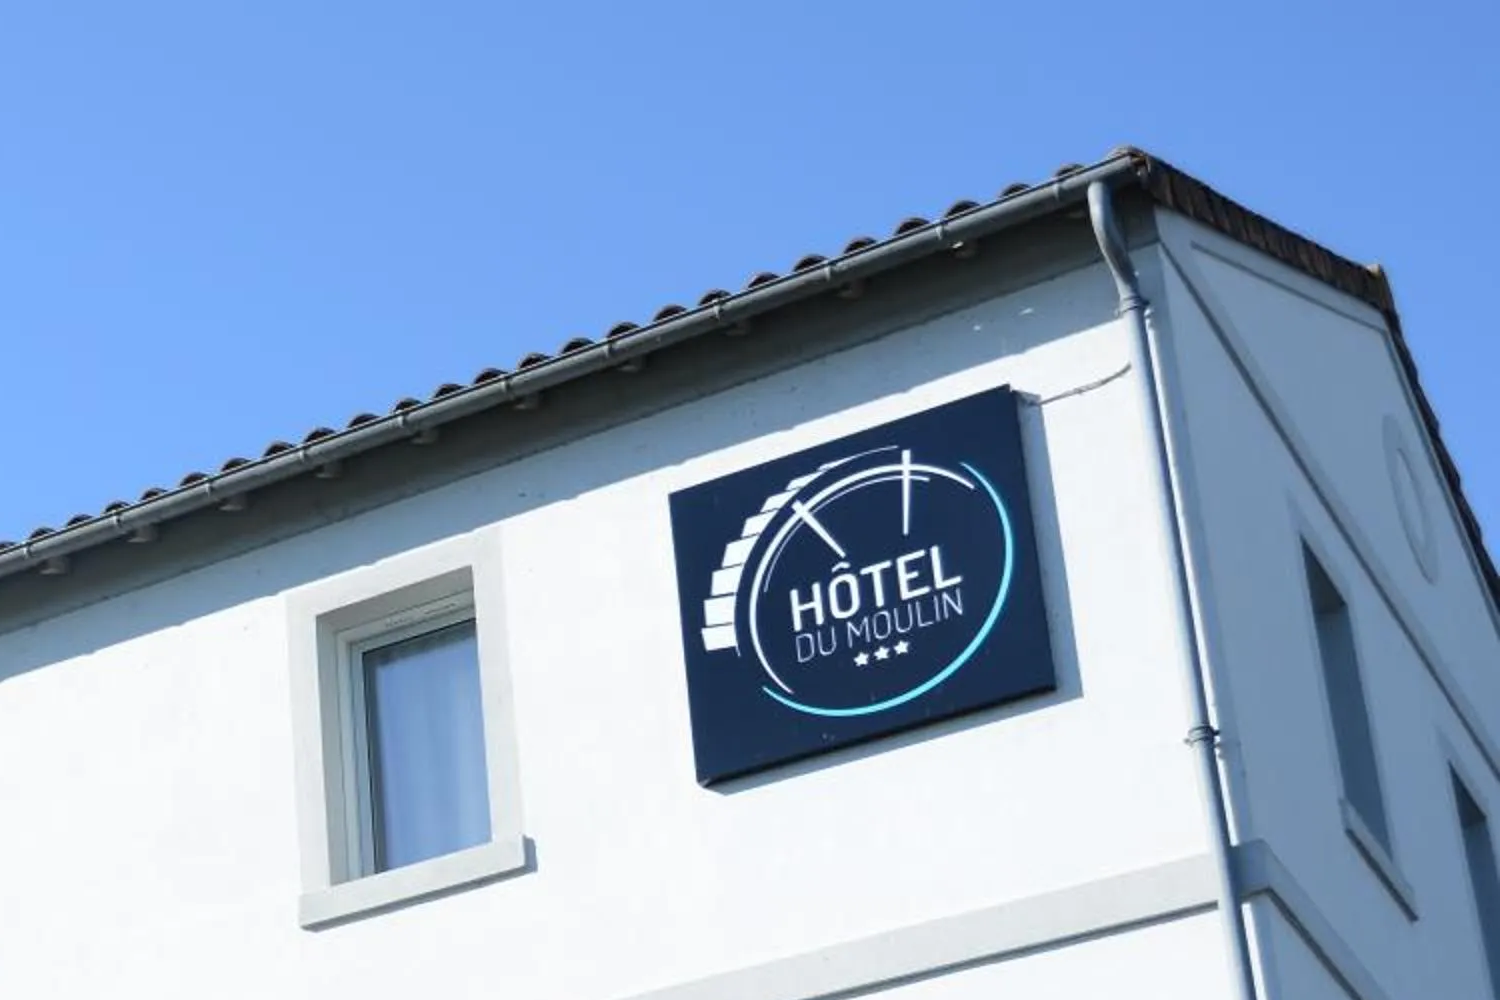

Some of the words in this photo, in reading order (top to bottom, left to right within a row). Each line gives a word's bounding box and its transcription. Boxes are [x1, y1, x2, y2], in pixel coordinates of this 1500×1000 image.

[790, 545, 962, 632] HÔTEL
[795, 627, 837, 663] DU
[846, 588, 963, 648] MOULIN
